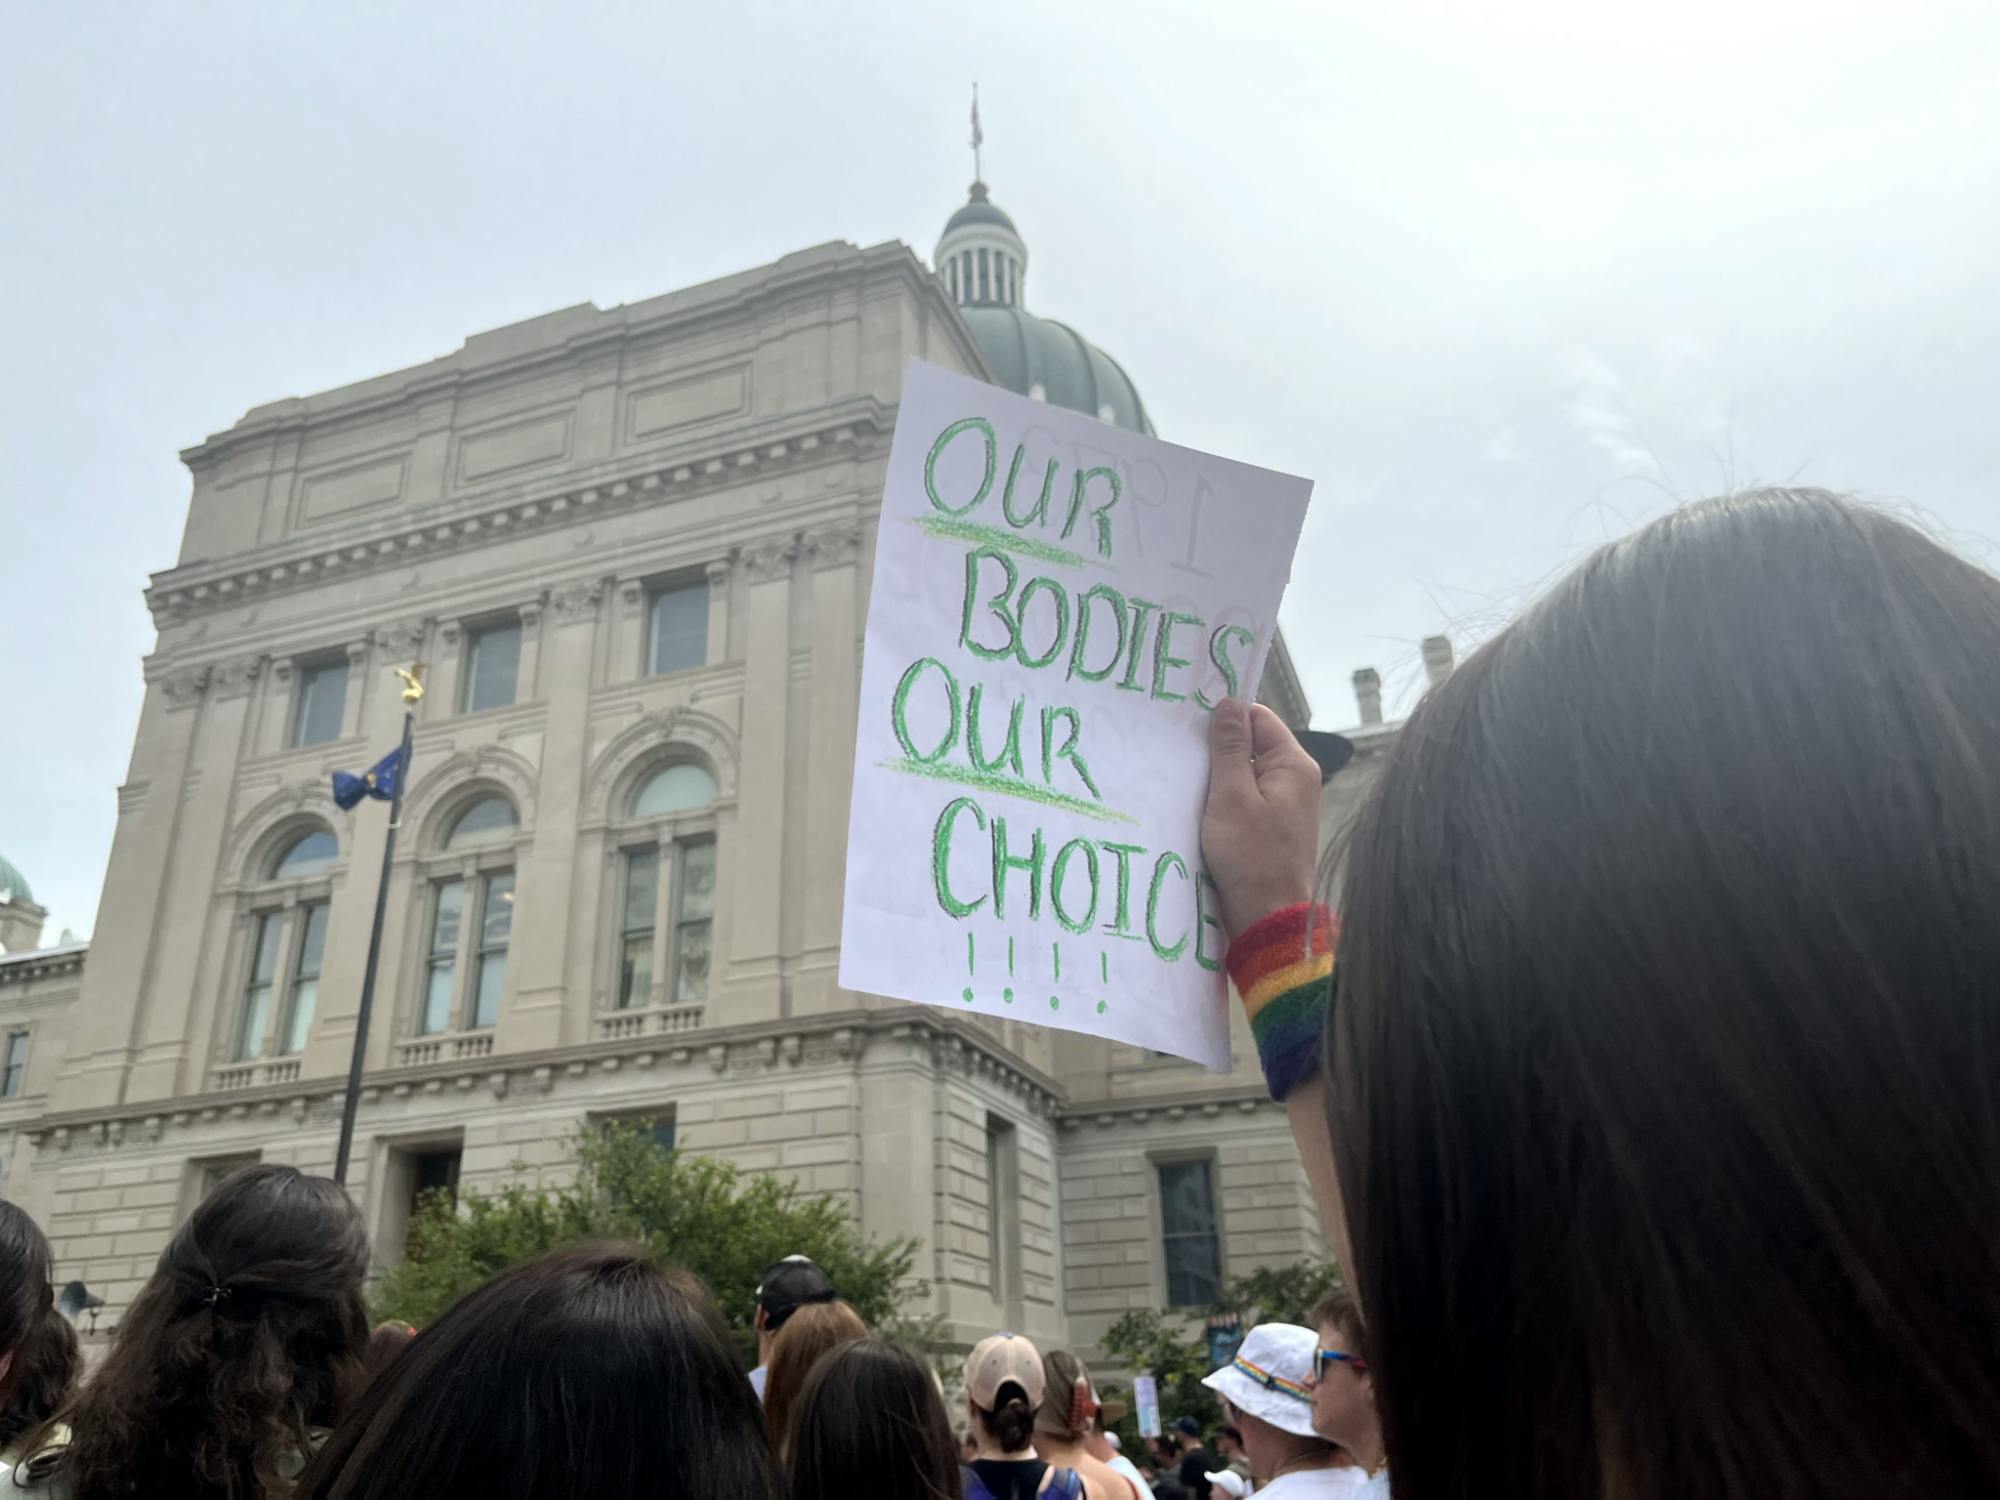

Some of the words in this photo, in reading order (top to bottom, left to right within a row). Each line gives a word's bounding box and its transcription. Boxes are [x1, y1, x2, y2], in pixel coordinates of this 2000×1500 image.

[924, 417, 1122, 558] OUR
[959, 545, 1254, 711] BODIES
[891, 657, 1101, 800] OUR
[932, 797, 1222, 972] CHOICE
